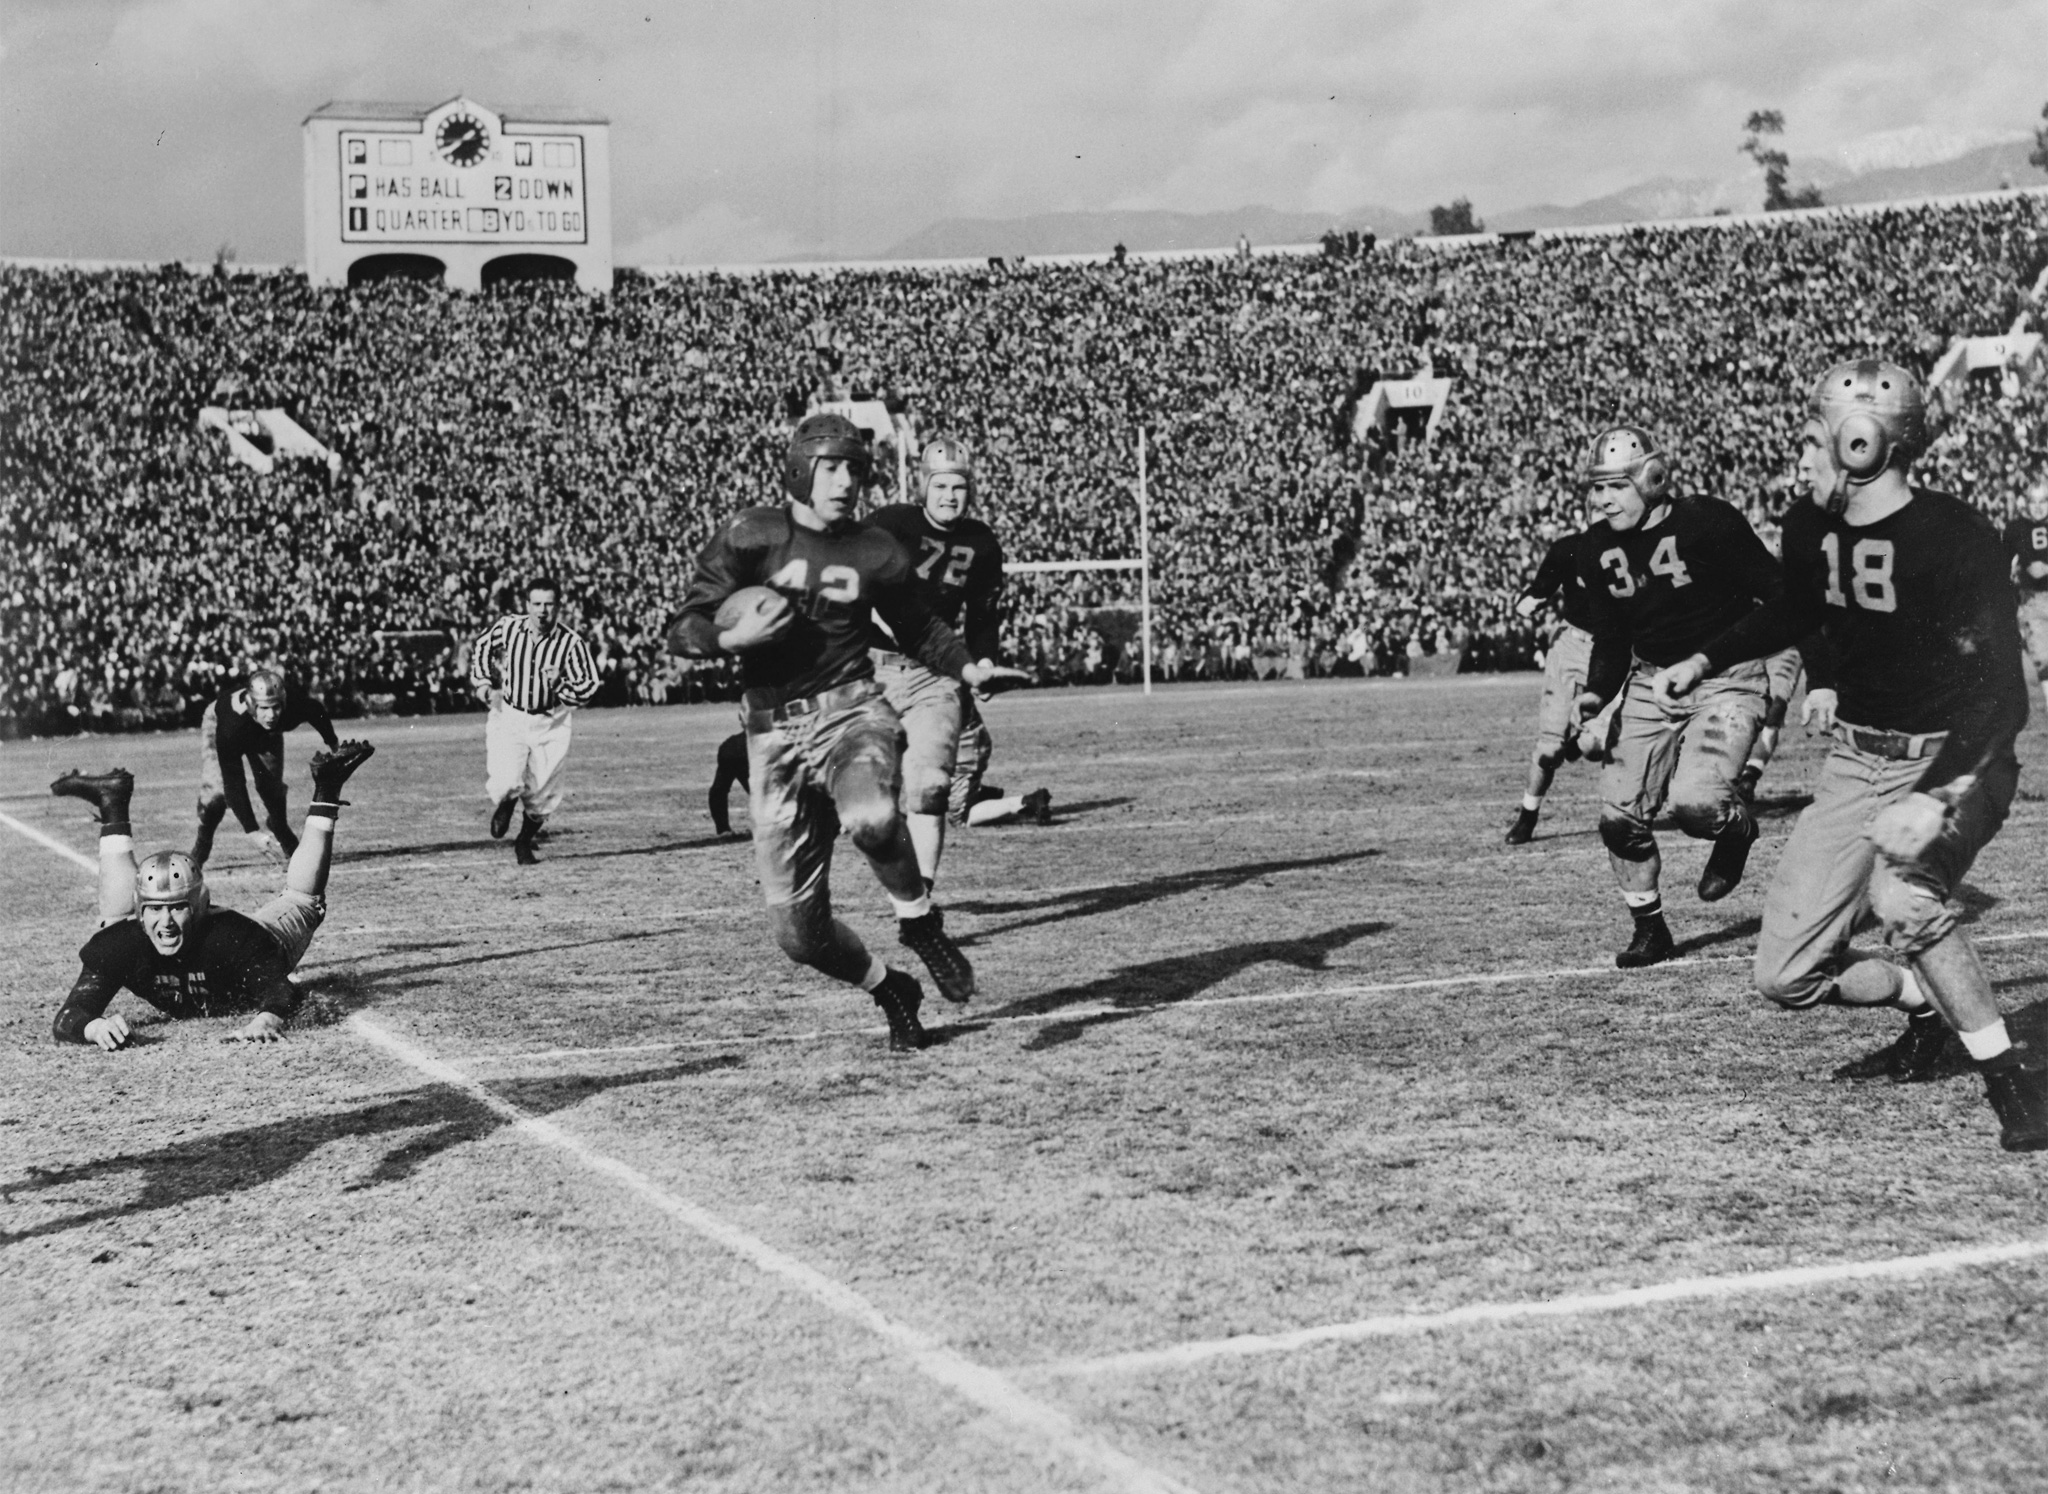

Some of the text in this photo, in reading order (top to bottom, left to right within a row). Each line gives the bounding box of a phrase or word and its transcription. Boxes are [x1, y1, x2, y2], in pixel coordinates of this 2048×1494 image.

[349, 140, 366, 164] P
[515, 142, 532, 166] W
[350, 175, 465, 198] P HAS BALL
[495, 176, 574, 200] 2 DOWN
[375, 210, 463, 233] QUARTER
[537, 211, 557, 232] TO
[562, 211, 581, 232] GO
[1405, 387, 1422, 400] 10
[914, 536, 976, 588] 72
[1600, 535, 1693, 599] 34
[1820, 531, 1898, 613] 18
[766, 558, 860, 619] 42
